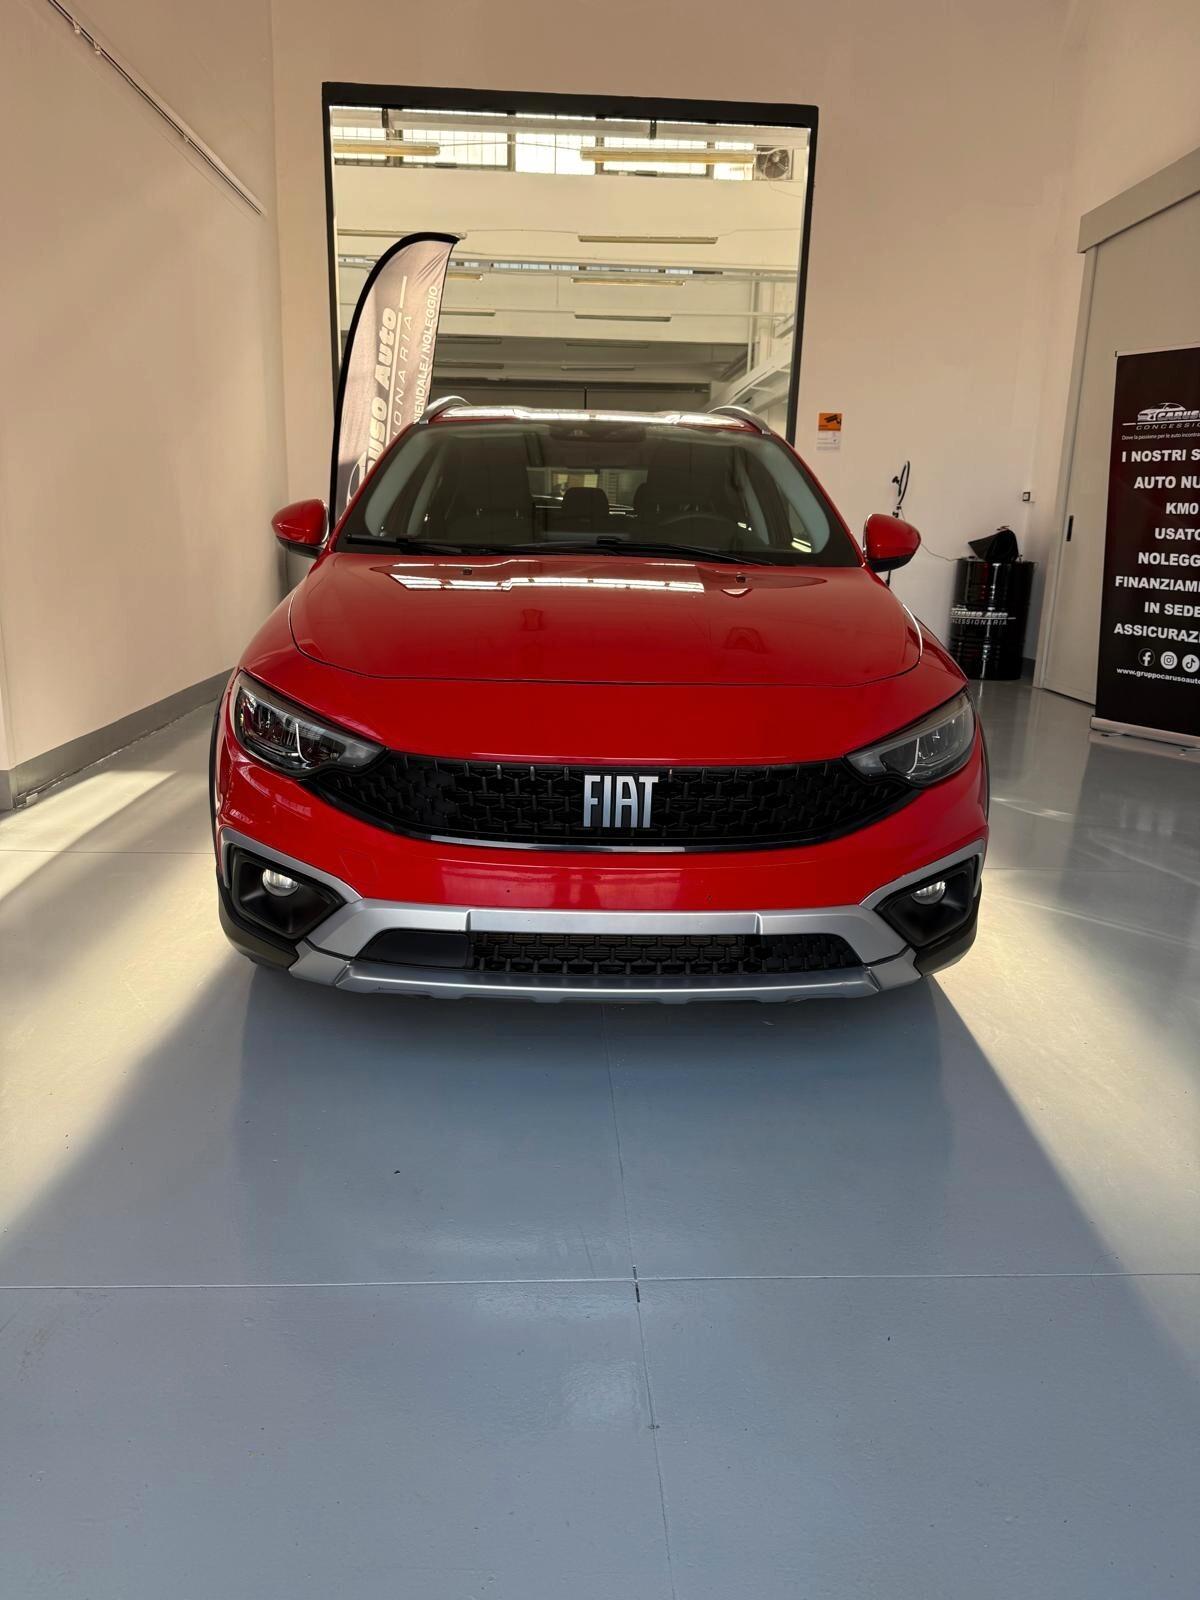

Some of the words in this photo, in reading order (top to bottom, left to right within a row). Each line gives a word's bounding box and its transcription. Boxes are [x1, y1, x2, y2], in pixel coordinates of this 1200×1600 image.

[422, 286, 438, 354] NOLEGGIO
[1157, 410, 1200, 421] CARUS
[1122, 451, 1127, 462] I
[1131, 449, 1187, 462] NOSTRI
[1133, 475, 1177, 489] AUTO
[1138, 552, 1200, 566] NOLEGG
[1115, 575, 1200, 593] FINANZIAM
[1144, 601, 1160, 614] IN
[1164, 603, 1200, 618] SEDE
[583, 774, 659, 828] FIAT
